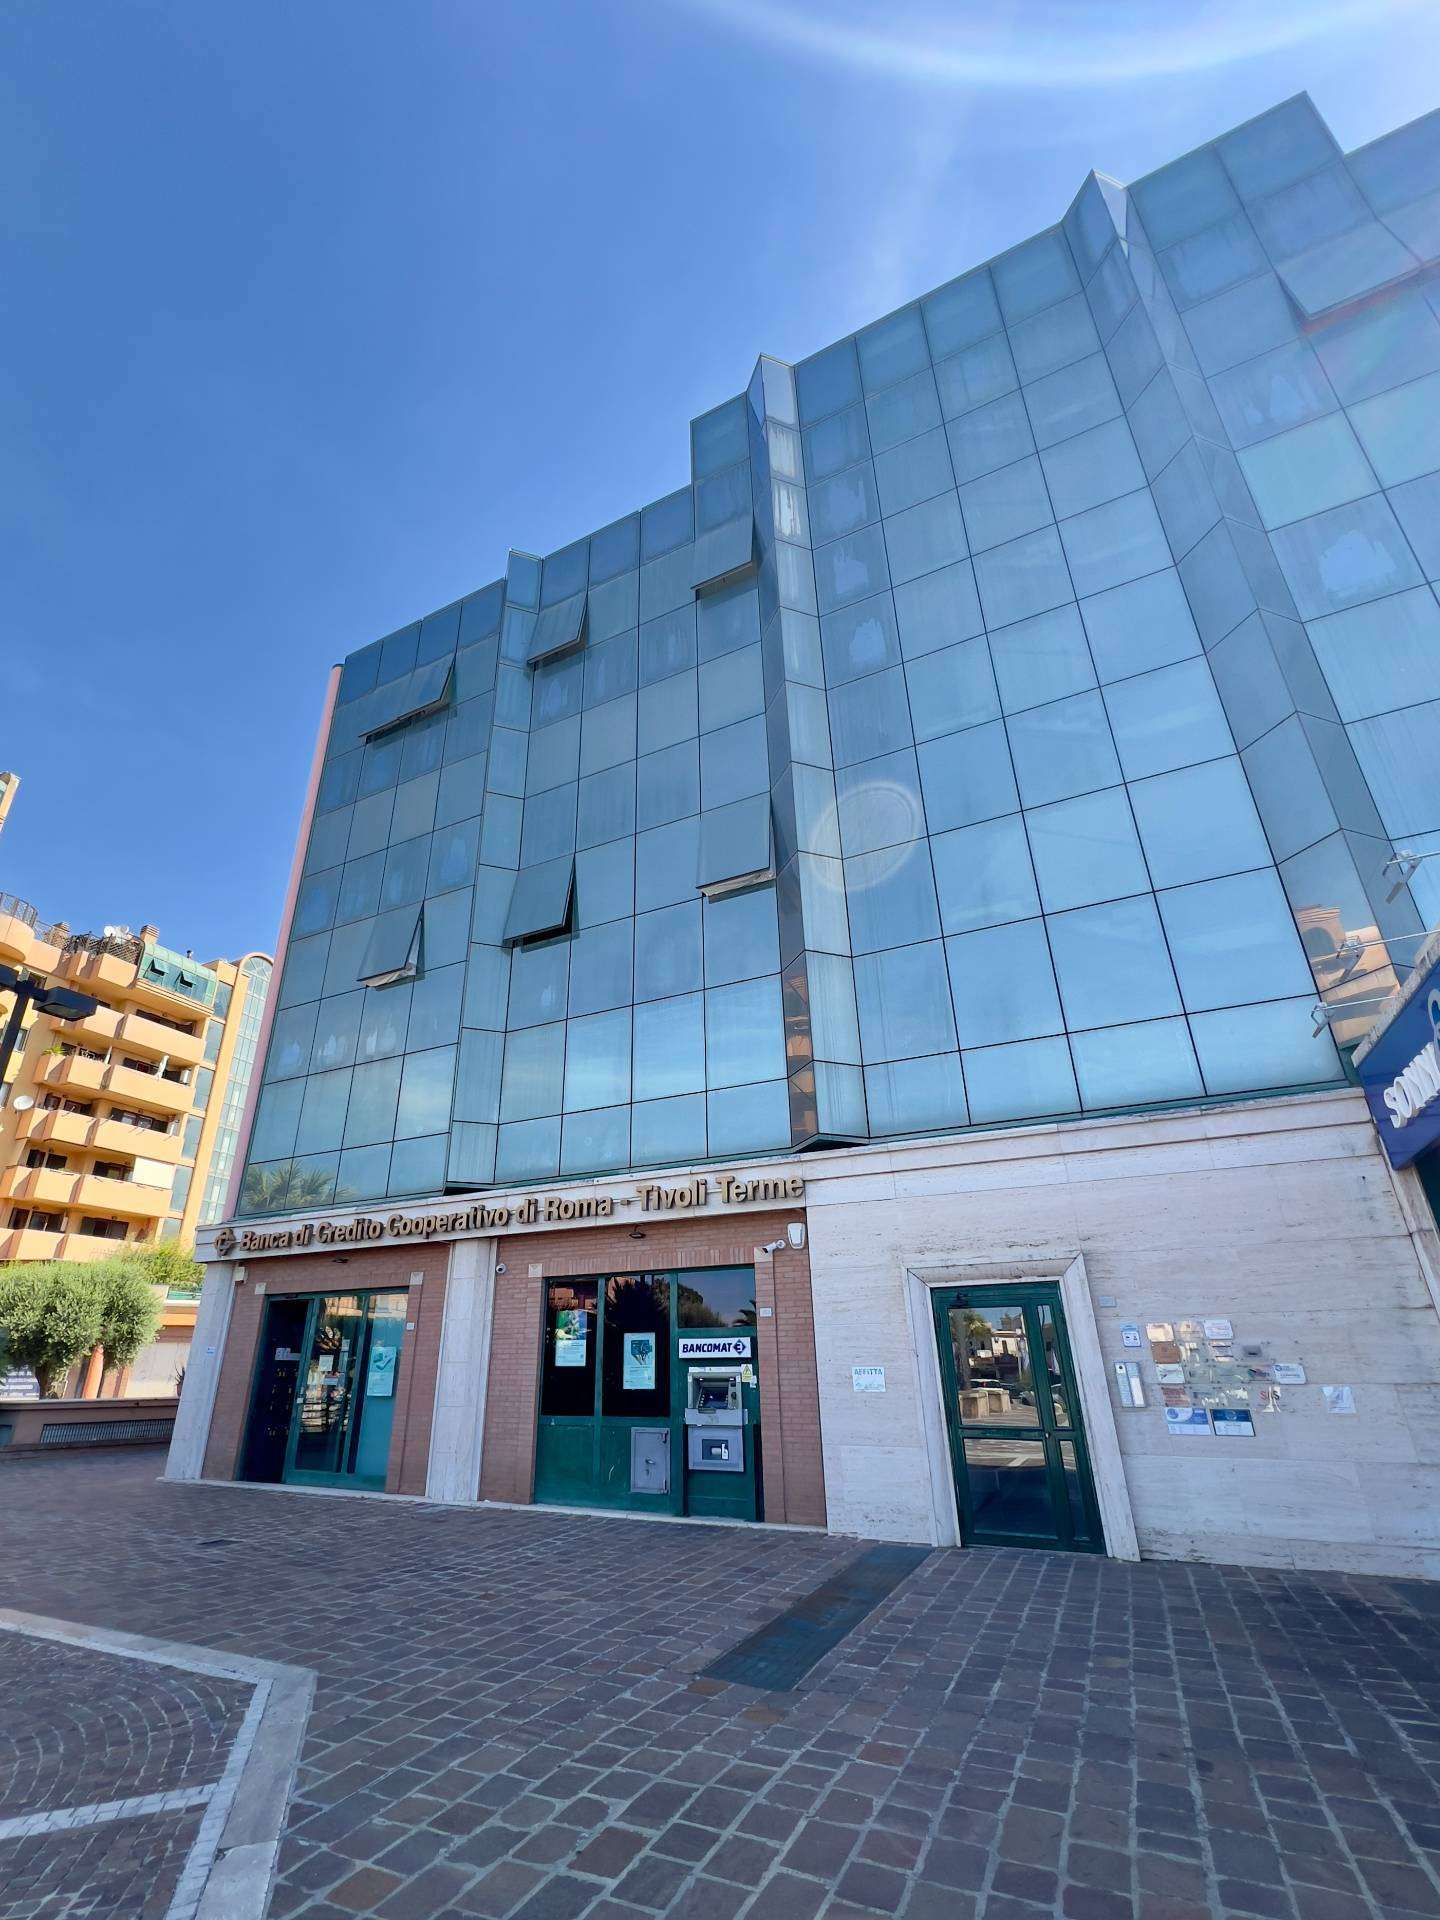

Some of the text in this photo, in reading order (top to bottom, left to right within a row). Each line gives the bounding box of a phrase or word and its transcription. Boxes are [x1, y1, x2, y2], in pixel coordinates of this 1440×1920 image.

[240, 1230, 290, 1251] Banca
[293, 1225, 311, 1247] di
[315, 1217, 384, 1244] Credito
[387, 1204, 509, 1239] Cooperativo
[517, 1198, 538, 1224] di
[544, 1196, 613, 1221] Roma
[636, 1179, 707, 1211] Tivoli
[716, 1175, 805, 1203] Terme
[682, 1343, 732, 1353] BANCOMAT
